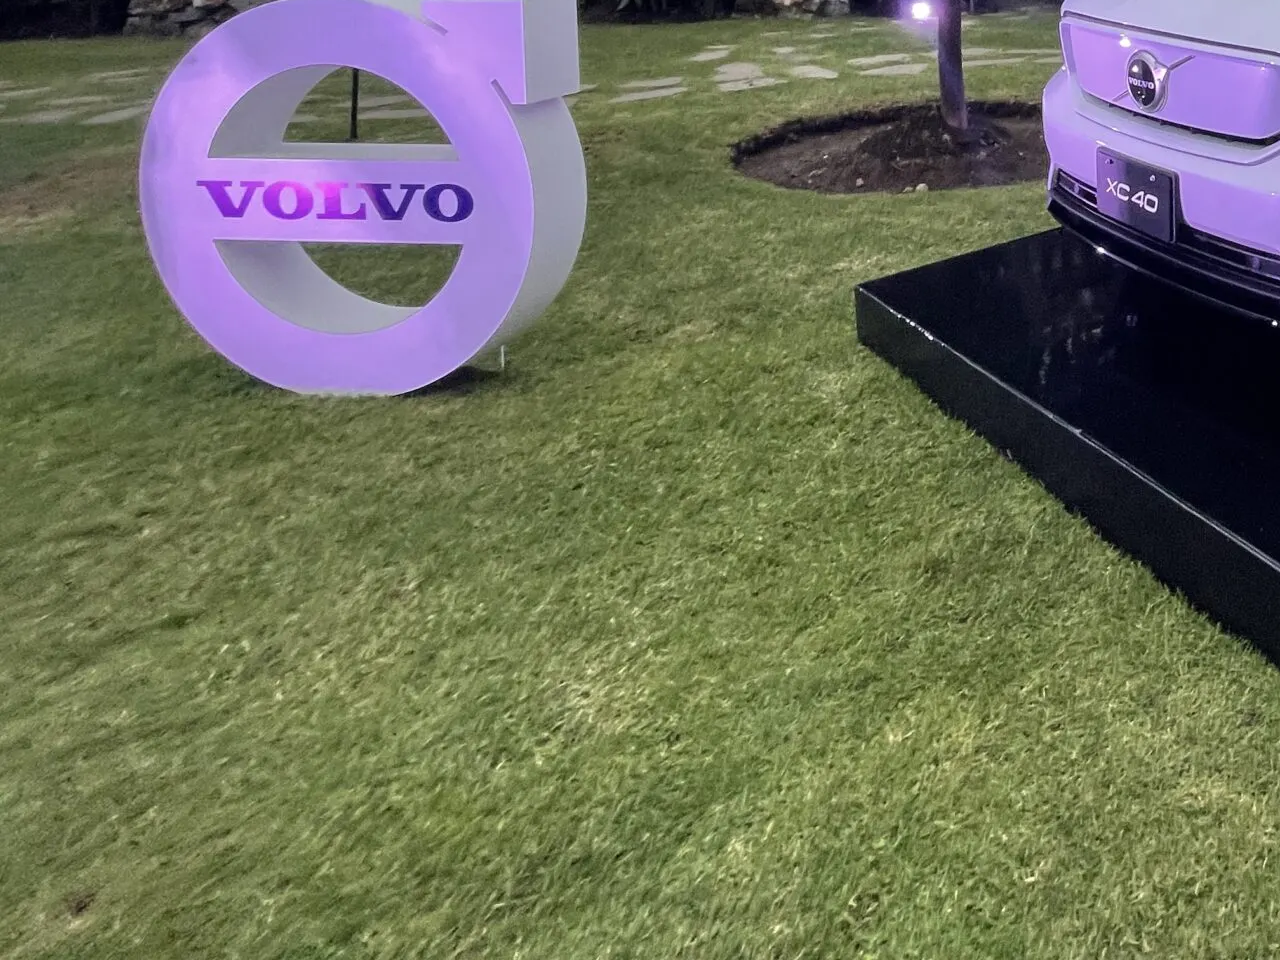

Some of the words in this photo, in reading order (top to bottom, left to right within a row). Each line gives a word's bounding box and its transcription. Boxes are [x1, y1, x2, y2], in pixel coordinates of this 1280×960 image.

[1128, 76, 1154, 90] VOLVO
[196, 180, 475, 223] VOLVO
[1106, 177, 1159, 213] XC40
